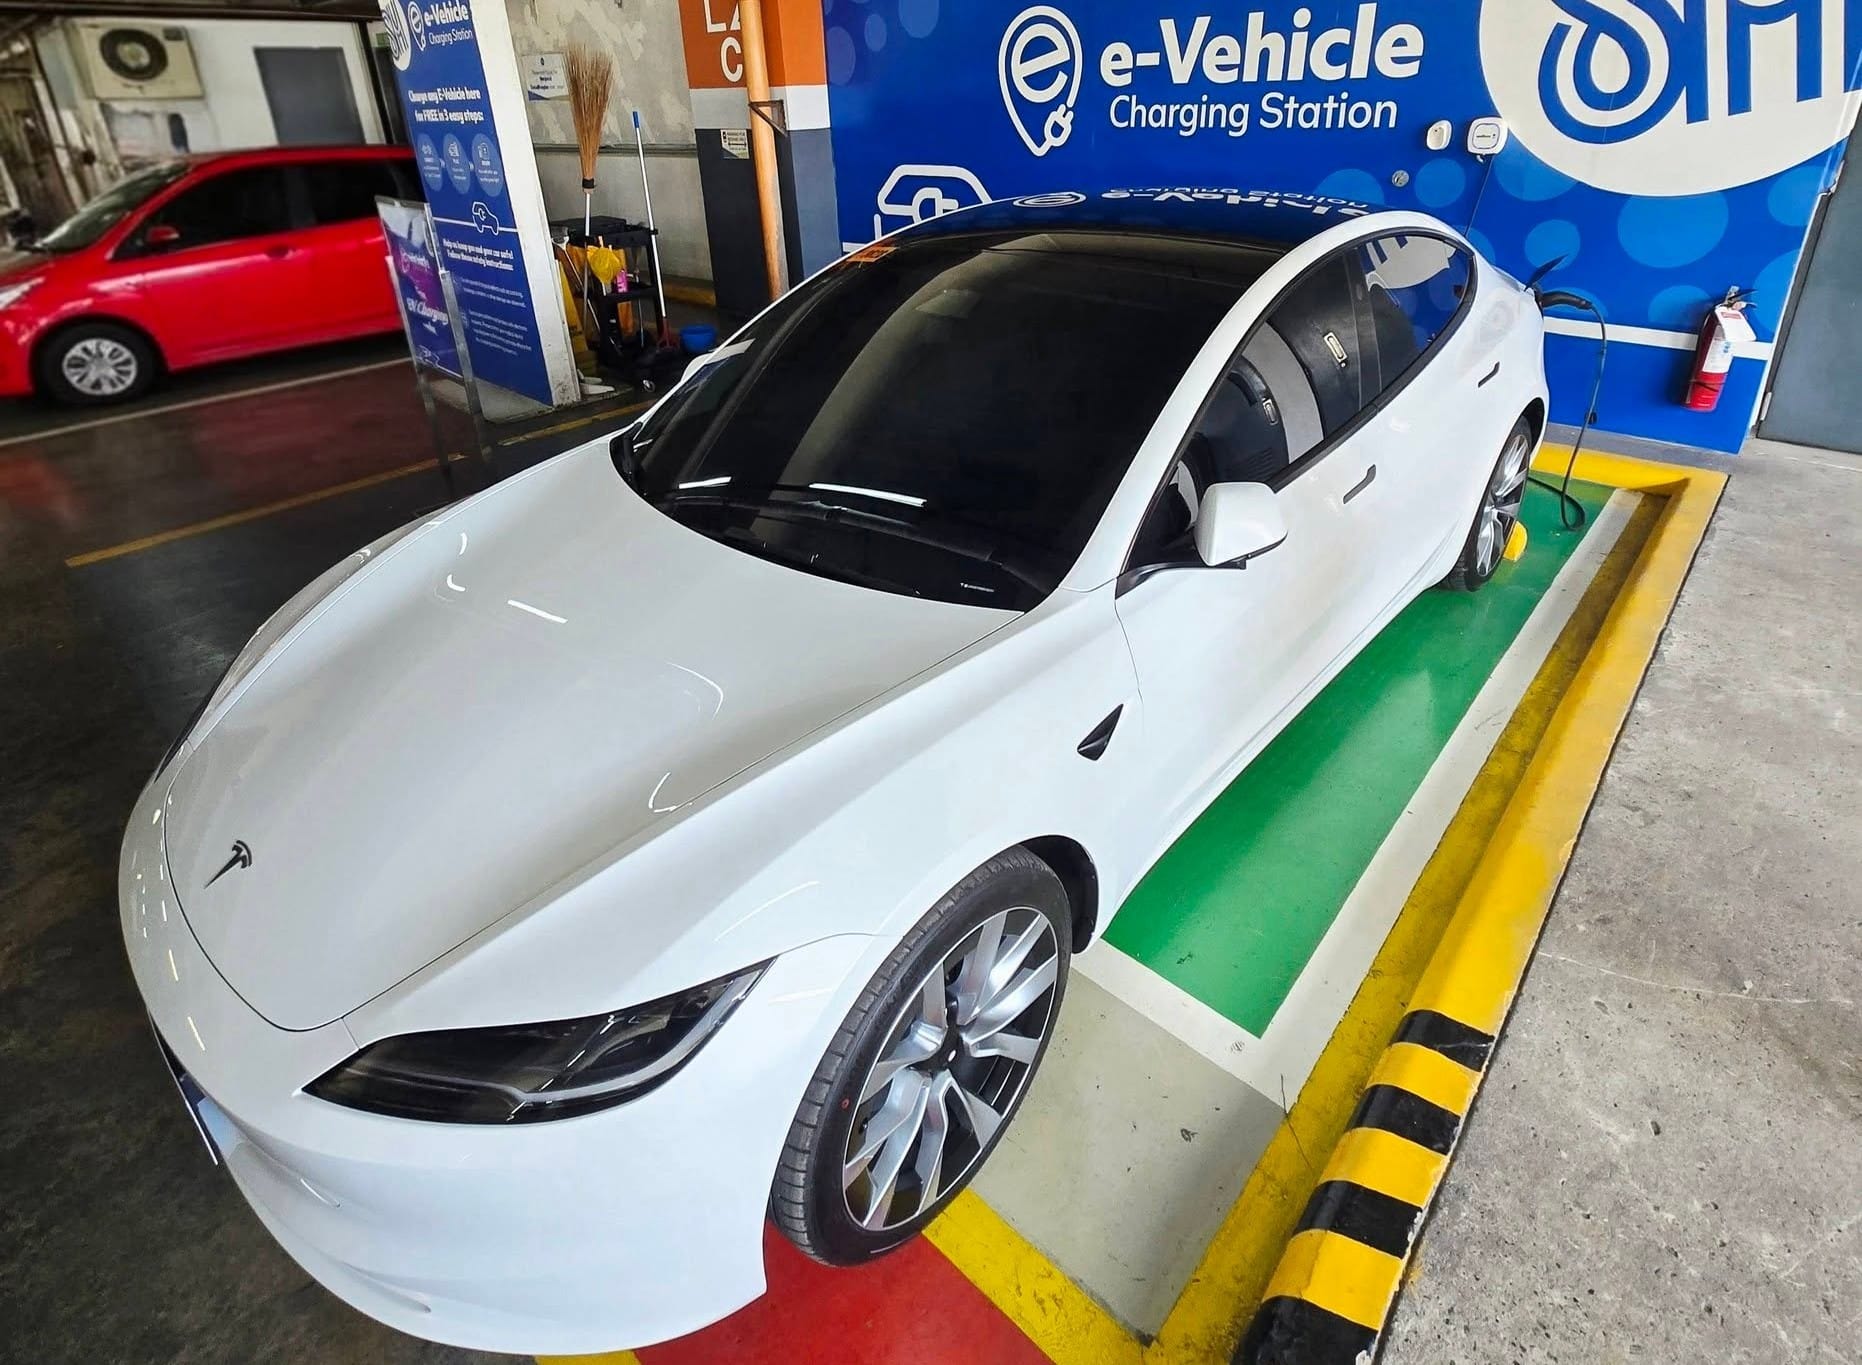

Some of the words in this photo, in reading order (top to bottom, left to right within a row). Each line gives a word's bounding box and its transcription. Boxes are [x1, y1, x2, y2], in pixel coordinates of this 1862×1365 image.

[424, 0, 469, 26] e-Vehicle
[428, 31, 453, 46] Charging
[452, 28, 474, 42] Station
[1100, 2, 1424, 87] e-Vehicle
[1109, 94, 1249, 137] Charging
[1259, 91, 1397, 129] Station
